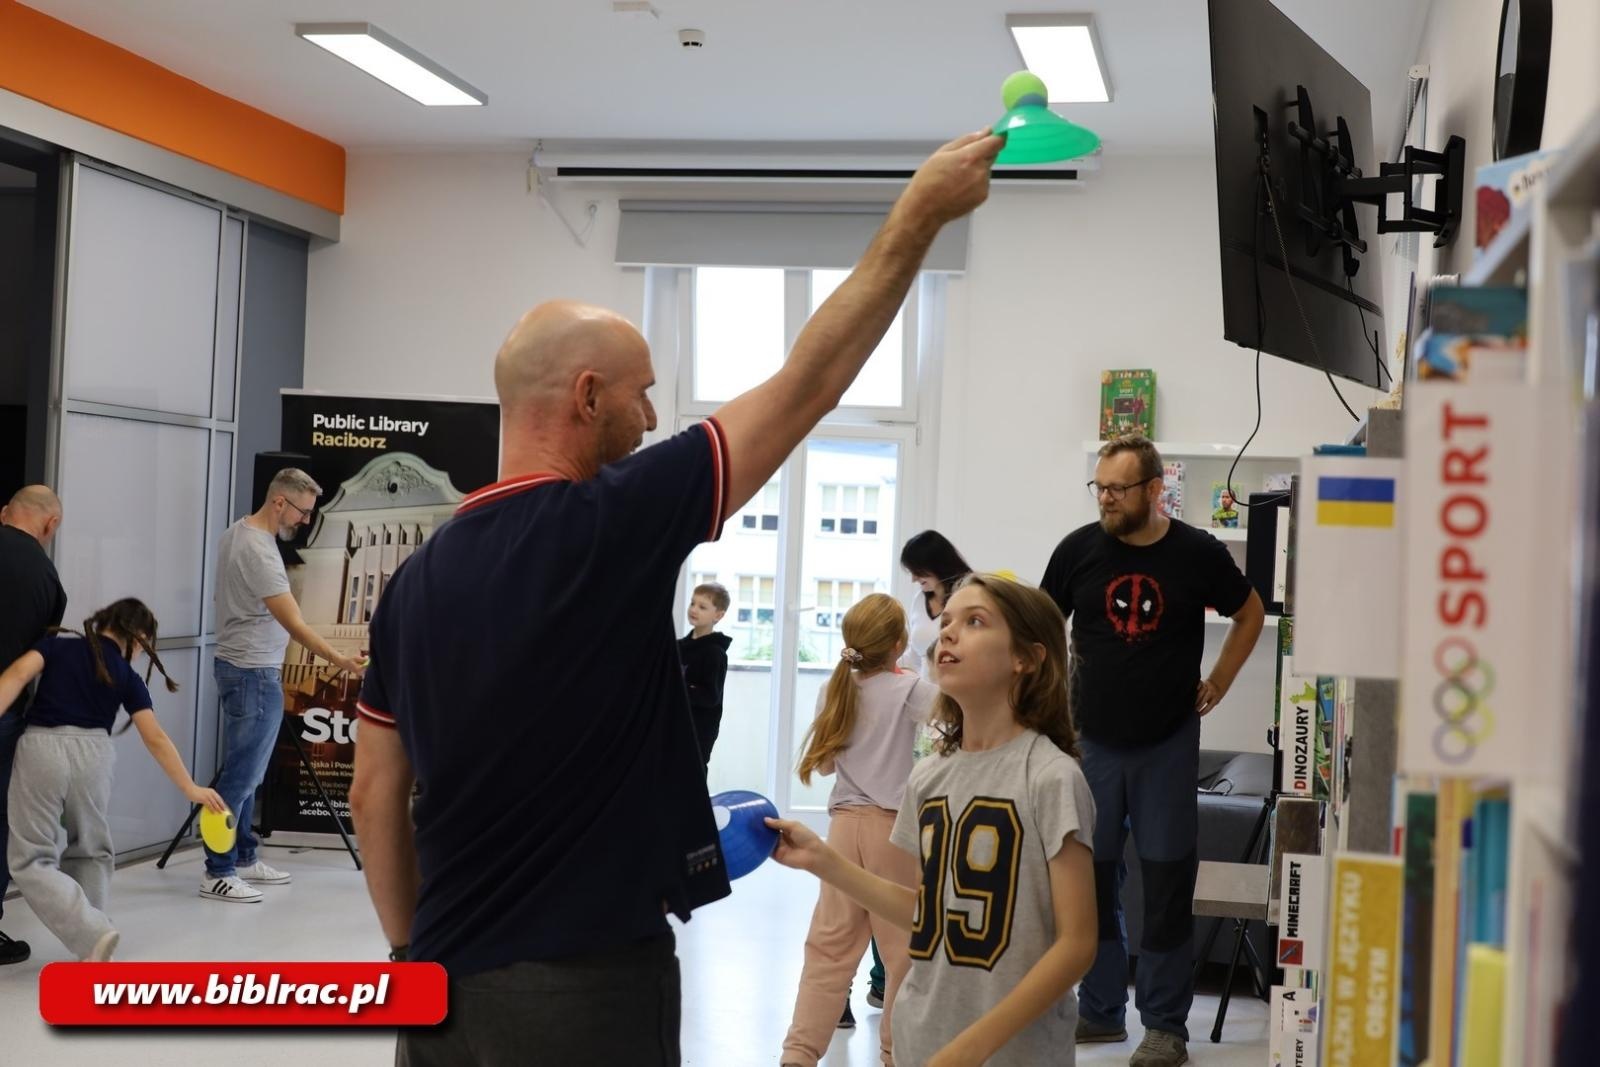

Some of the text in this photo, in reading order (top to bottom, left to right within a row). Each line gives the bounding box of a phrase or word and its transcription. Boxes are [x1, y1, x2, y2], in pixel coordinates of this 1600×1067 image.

[312, 431, 386, 448] Raciborz
[313, 413, 429, 436] Public Library
[1439, 402, 1491, 630] SPORT
[1294, 706, 1309, 790] DINOZAURY
[1287, 861, 1301, 937] MINECRAFT
